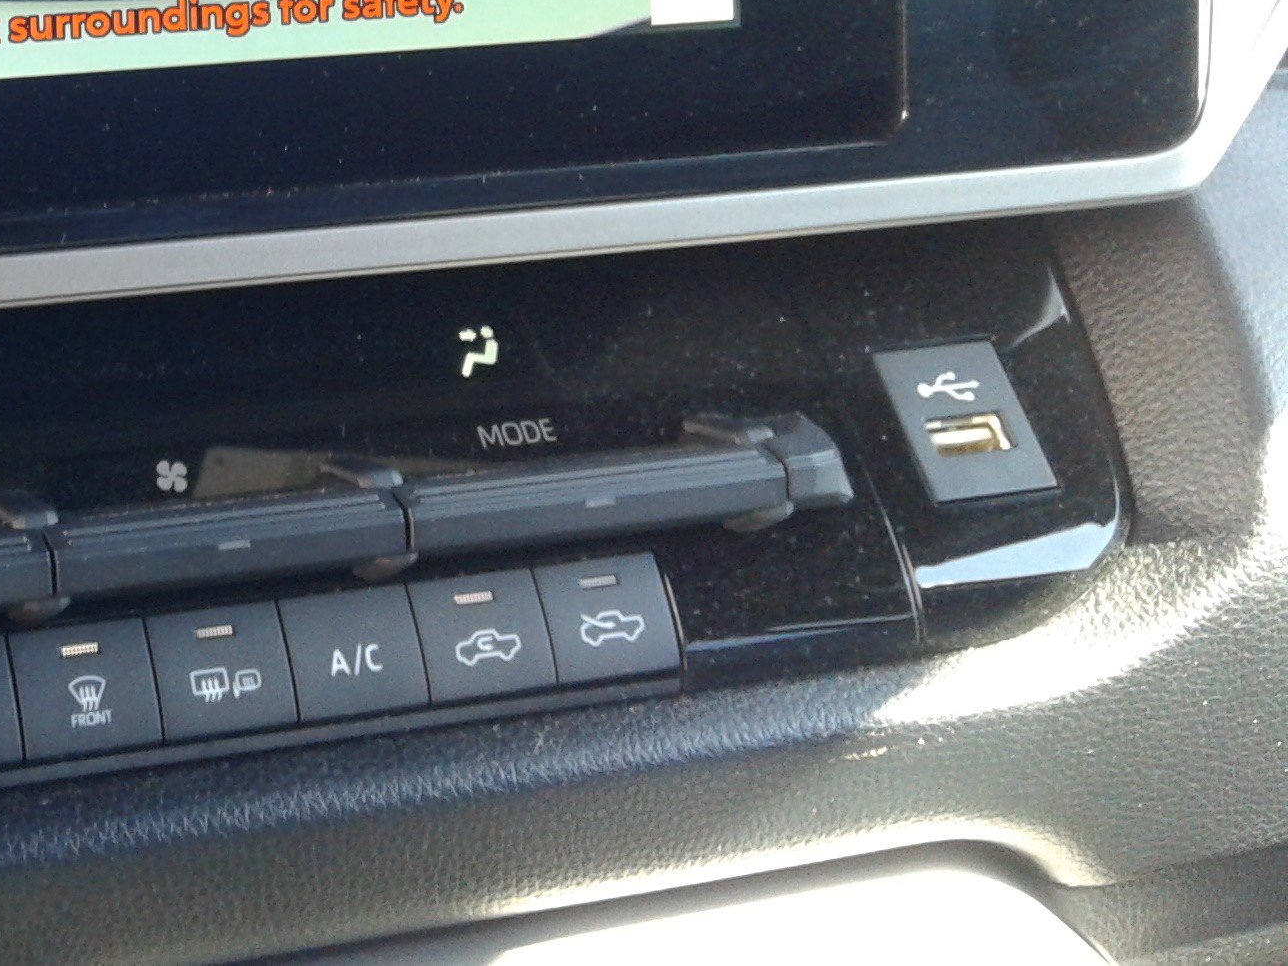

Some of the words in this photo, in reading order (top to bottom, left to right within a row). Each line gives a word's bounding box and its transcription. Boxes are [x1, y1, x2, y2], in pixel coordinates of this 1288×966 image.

[476, 417, 558, 449] MODE
[330, 643, 384, 678] A/C
[70, 707, 113, 729] FRONT
